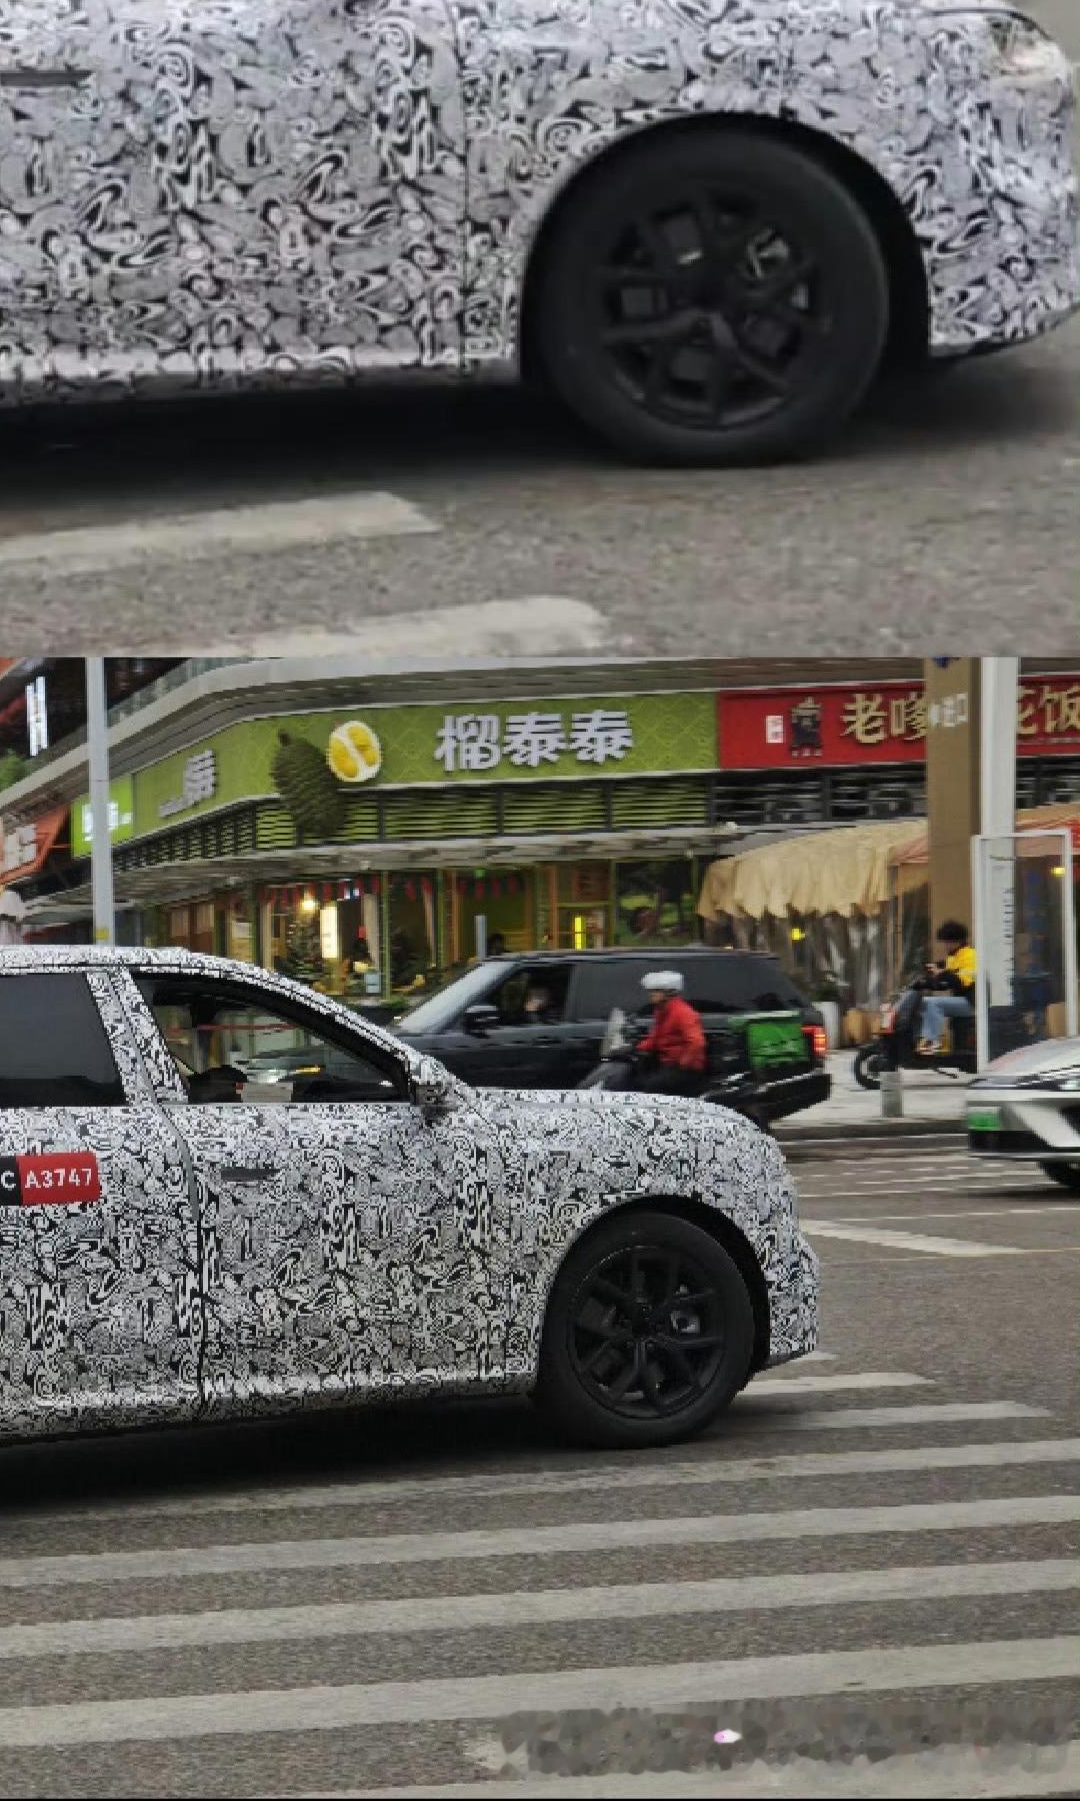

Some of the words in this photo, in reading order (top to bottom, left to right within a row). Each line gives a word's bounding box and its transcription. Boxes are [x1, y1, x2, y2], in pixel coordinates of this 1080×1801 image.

[433, 709, 633, 772] 榴泰泰
[24, 1167, 93, 1189] A3747
